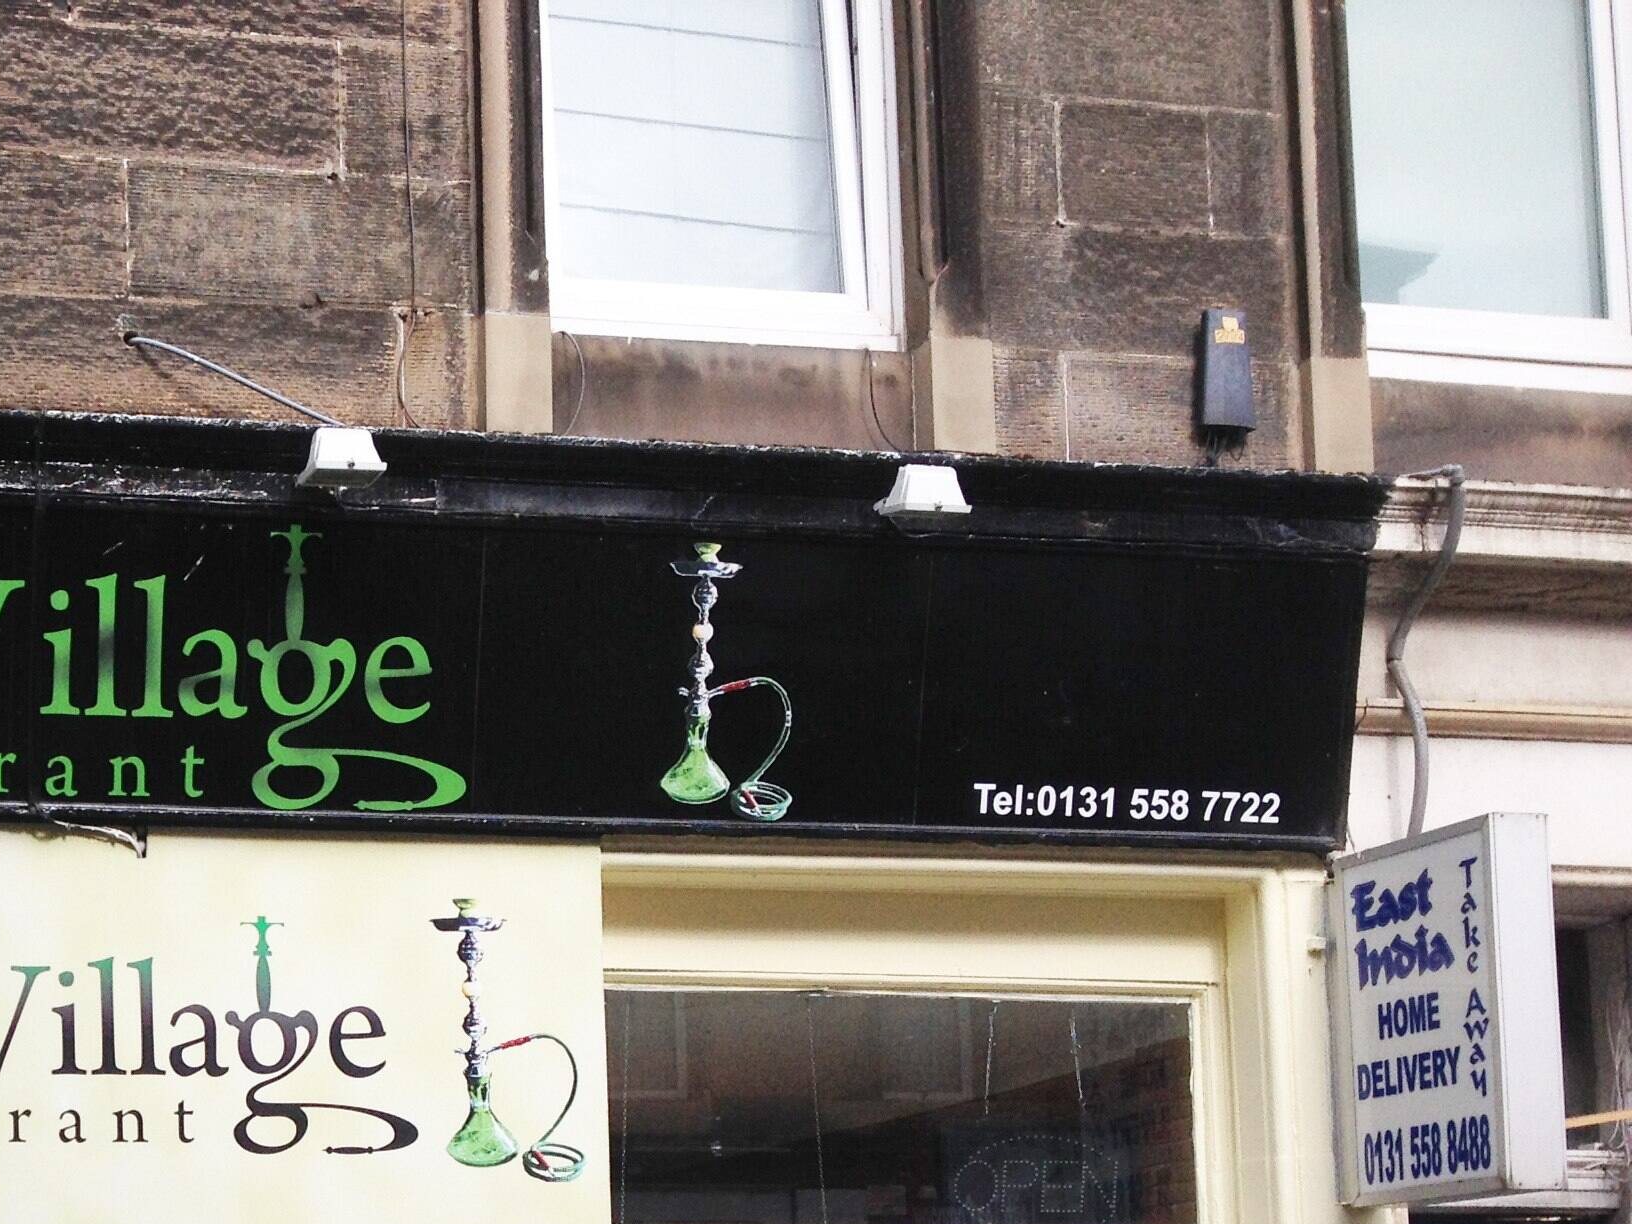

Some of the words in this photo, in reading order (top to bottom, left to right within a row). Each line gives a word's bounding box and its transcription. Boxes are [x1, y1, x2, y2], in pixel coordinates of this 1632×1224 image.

[973, 782, 1116, 819] Tel:0131
[1129, 788, 1190, 822] 558
[1201, 790, 1282, 824] 7722
[1349, 867, 1434, 934] East
[1457, 855, 1482, 975] Take
[1354, 923, 1455, 991] India
[1377, 991, 1441, 1042] HOME
[1463, 987, 1490, 1098] Away
[1357, 1045, 1461, 1101] DELIVERY
[1363, 1126, 1405, 1187] 0131
[1409, 1120, 1443, 1180] 558
[1446, 1113, 1492, 1175] 8488
[953, 1159, 1118, 1214] OPEN
